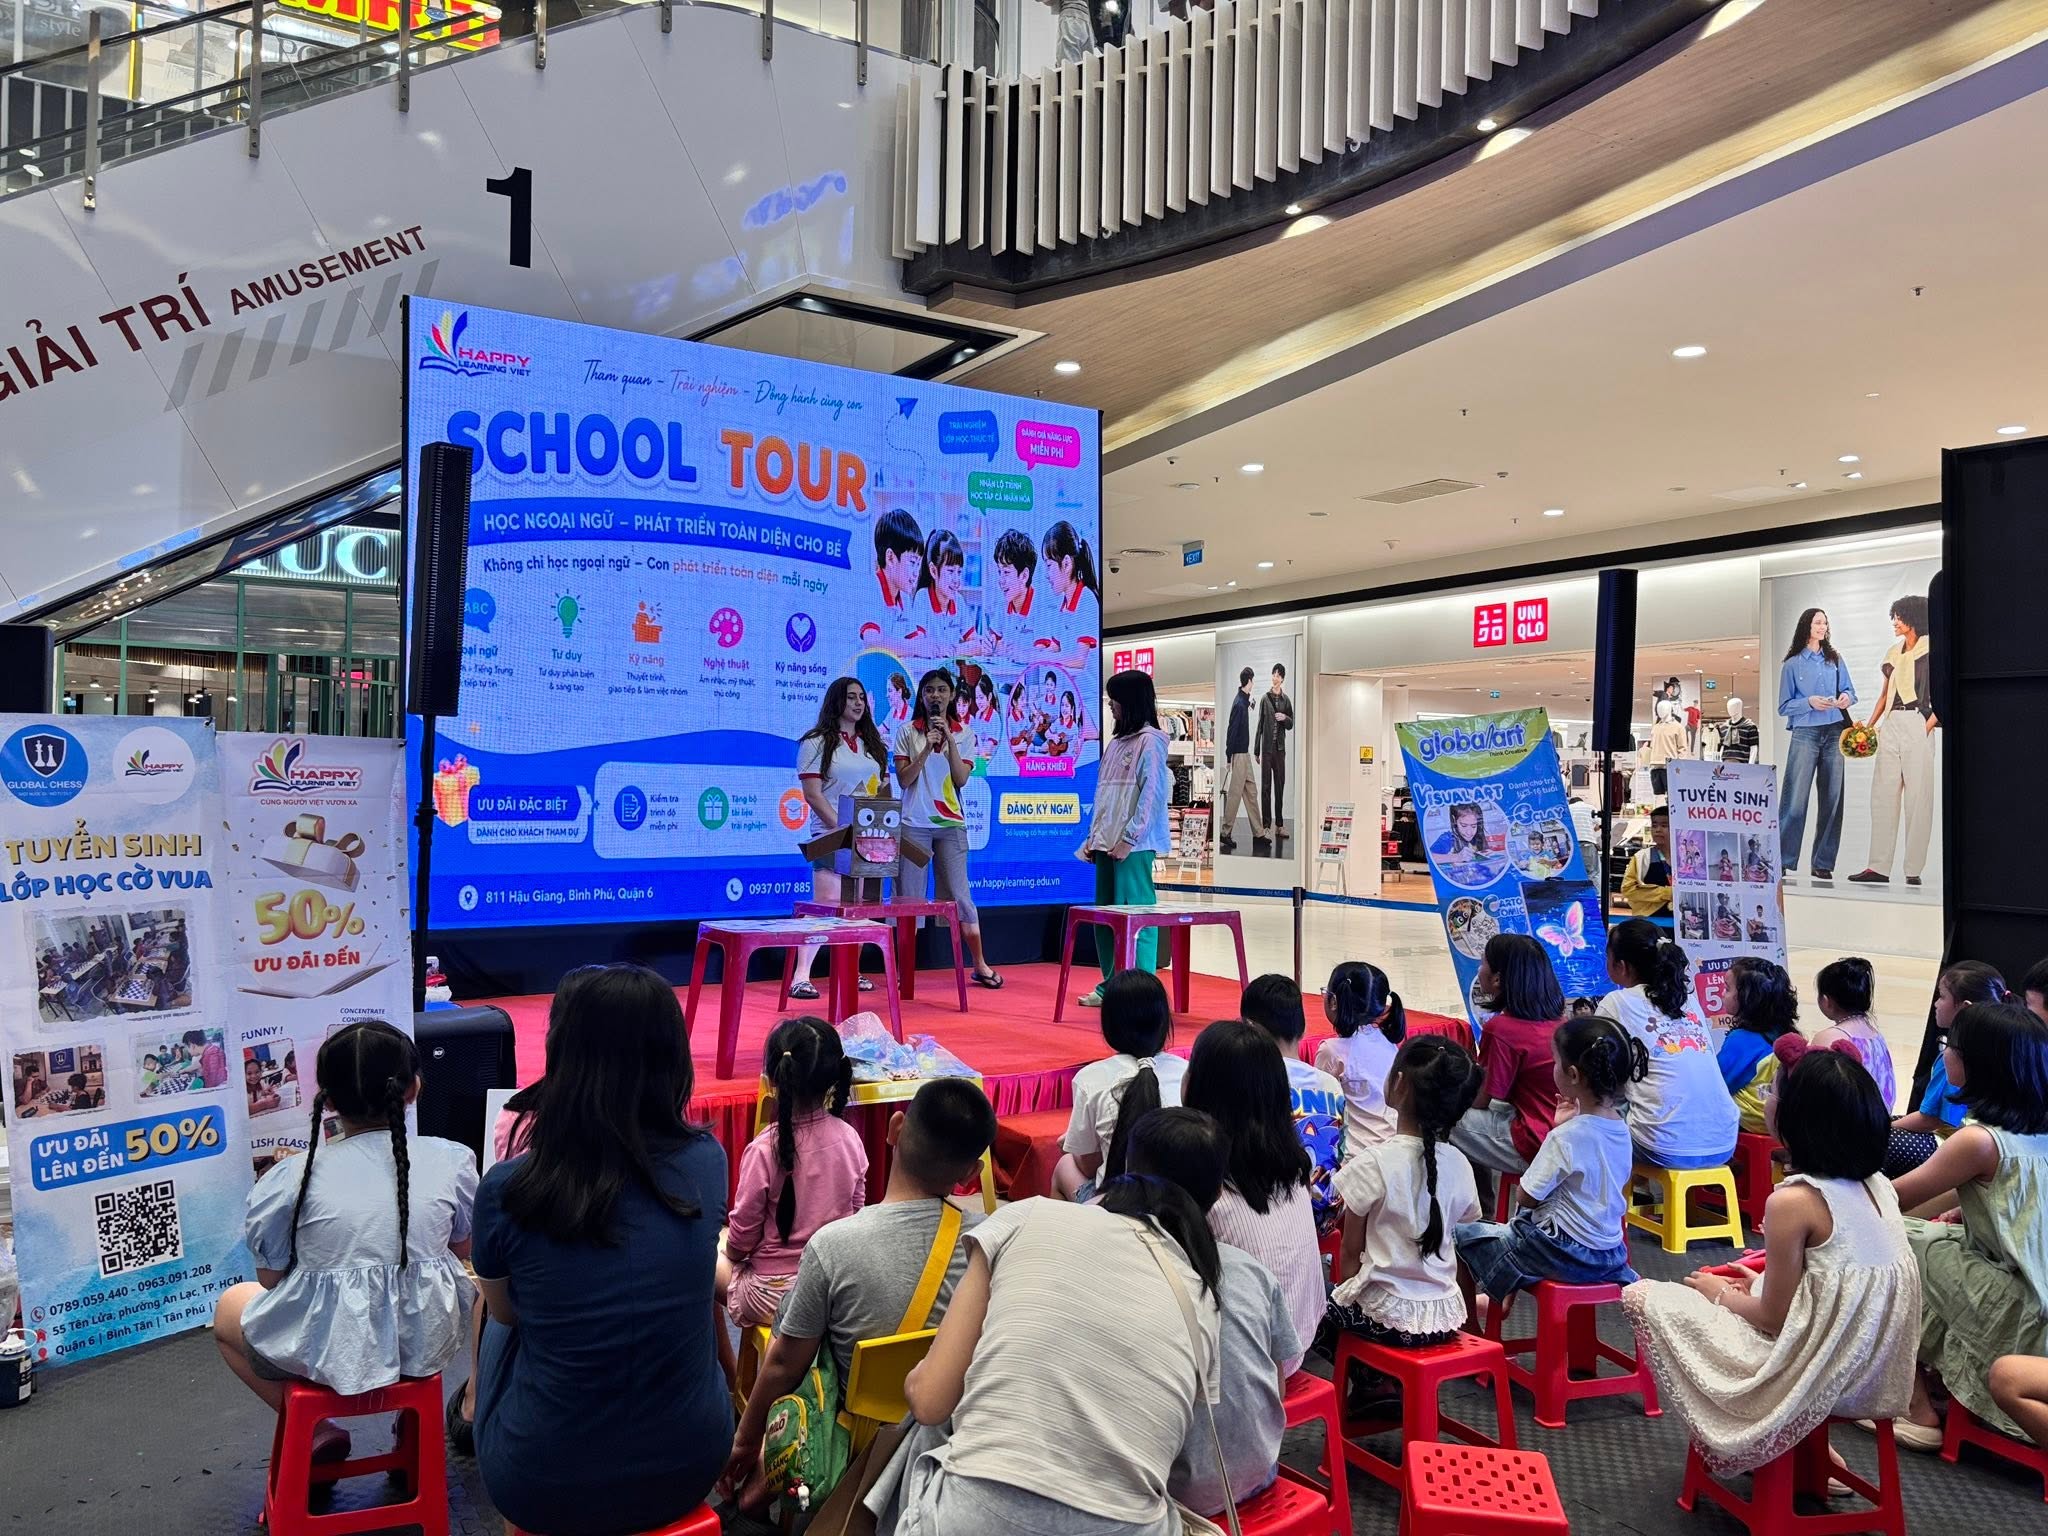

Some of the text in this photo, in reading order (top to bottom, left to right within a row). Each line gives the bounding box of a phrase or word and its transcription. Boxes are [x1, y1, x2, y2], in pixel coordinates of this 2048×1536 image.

[40, 18, 80, 36] style
[486, 166, 532, 268] 1
[98, 271, 211, 352] TRÍ
[229, 225, 428, 315] AMUSEMENT
[458, 346, 531, 367] HAPPY
[458, 359, 531, 377] LEARNING VIET
[584, 359, 618, 384] Tham
[622, 373, 652, 395] quan
[670, 369, 695, 394] Trải
[697, 376, 739, 407] nghiệm
[791, 384, 819, 404] hành
[820, 394, 844, 422] cùng
[846, 400, 863, 410] con
[1050, 445, 1064, 459] PHÍ
[446, 410, 867, 513] SCHOOL TOUR
[483, 508, 842, 558] HỌC NGOẠI NGỮ PHÁT TRIỂN TOÀN DIỆN CHO BÉ
[242, 531, 387, 580] UC
[483, 554, 829, 595] Không chỉ học ngoại ngữ Con phát triển toàn diện mỗi ngày
[465, 602, 489, 615] ABC
[1517, 603, 1543, 621] UNI
[1517, 621, 1545, 641] QLO
[552, 648, 583, 663] Tư duy
[642, 654, 665, 668] năng
[703, 657, 750, 671] Nghệ thuật
[1136, 652, 1153, 665] UNI
[775, 661, 828, 676] Kỹ năng sống
[1504, 748, 1528, 756] Creative
[289, 769, 359, 781] HAPPY
[290, 779, 336, 788] LEARNING
[1529, 779, 1543, 787] cho
[7, 780, 83, 790] GLOBAL CHESS
[1412, 782, 1504, 809] VISUAL ART
[1677, 782, 1769, 808] TUYỂN SINH
[477, 797, 568, 815] ƯU ĐÃI ĐẶC BIỆT
[1006, 800, 1074, 815] ĐĂNG KÝ NGAY
[1687, 803, 1763, 826] KHÓA HỌC
[476, 825, 579, 839] DÀNH CHO KHÁCH THAM DỰ
[5, 817, 203, 866] TUYỂN SINH
[0, 862, 214, 903] LỚP HỌC CỜ VUA
[749, 881, 811, 895] 0937 017 885
[967, 874, 1060, 890] ww.happylearning.edu.vn
[485, 886, 654, 906] 811 Hậu Giang, Bình Phú, Quận 6
[254, 888, 365, 946] 50%
[253, 944, 361, 974] ƯU ĐÃI ĐẾN
[1706, 973, 1725, 985] LÊN
[340, 1007, 386, 1015] CONCENTRATE
[241, 1027, 278, 1042] FUNNY
[38, 1129, 109, 1158] ƯU ĐÃI
[125, 1114, 220, 1162] 50%
[250, 1137, 310, 1150] LISH CLASS
[40, 1146, 125, 1183] LÊN ĐẾN
[49, 1263, 213, 1317] 0789.059.440 0963.091.208
[52, 1274, 244, 1336] 55 Tên Lửa, phường An Lạc, TP. HCM
[55, 1303, 207, 1356] Quận 6 Bình Tân Tân Phú
